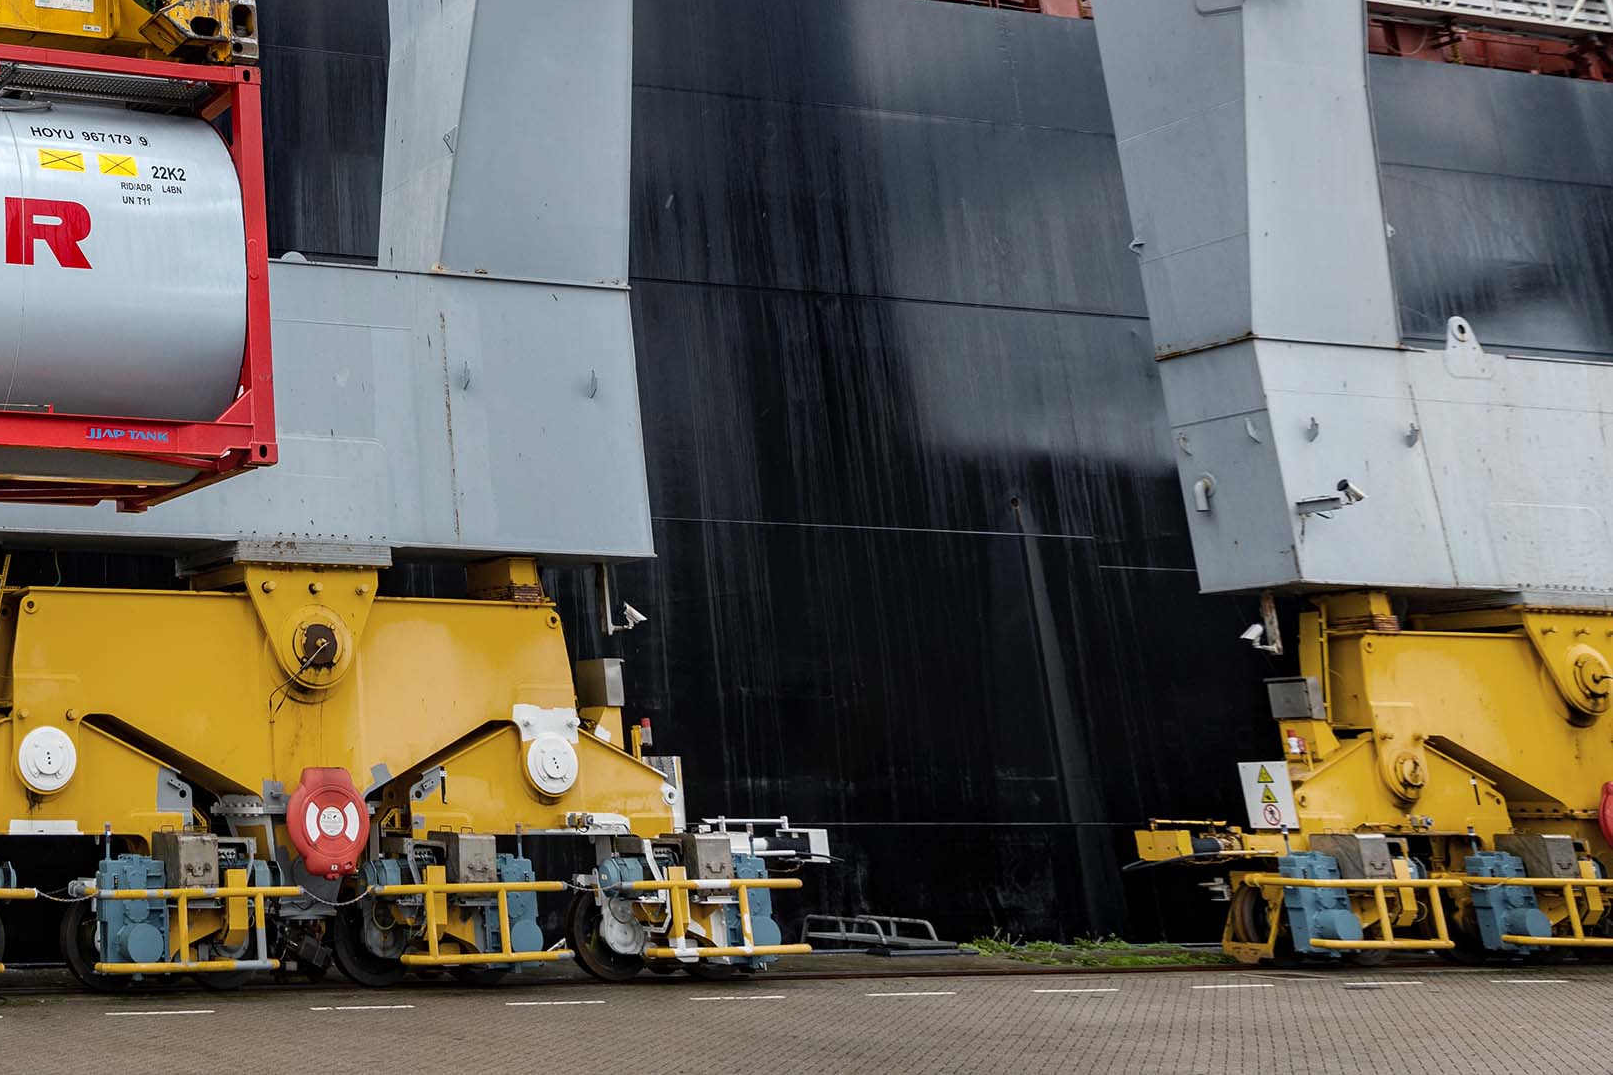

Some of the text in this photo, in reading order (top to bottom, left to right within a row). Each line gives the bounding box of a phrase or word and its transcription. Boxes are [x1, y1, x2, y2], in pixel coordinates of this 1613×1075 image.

[30, 126, 148, 146] HOYU 967179 9
[151, 166, 187, 181] 22K2
[120, 181, 183, 195] RID/ADR L4BN
[122, 196, 151, 206] UN T11
[127, 429, 169, 443] TANK
